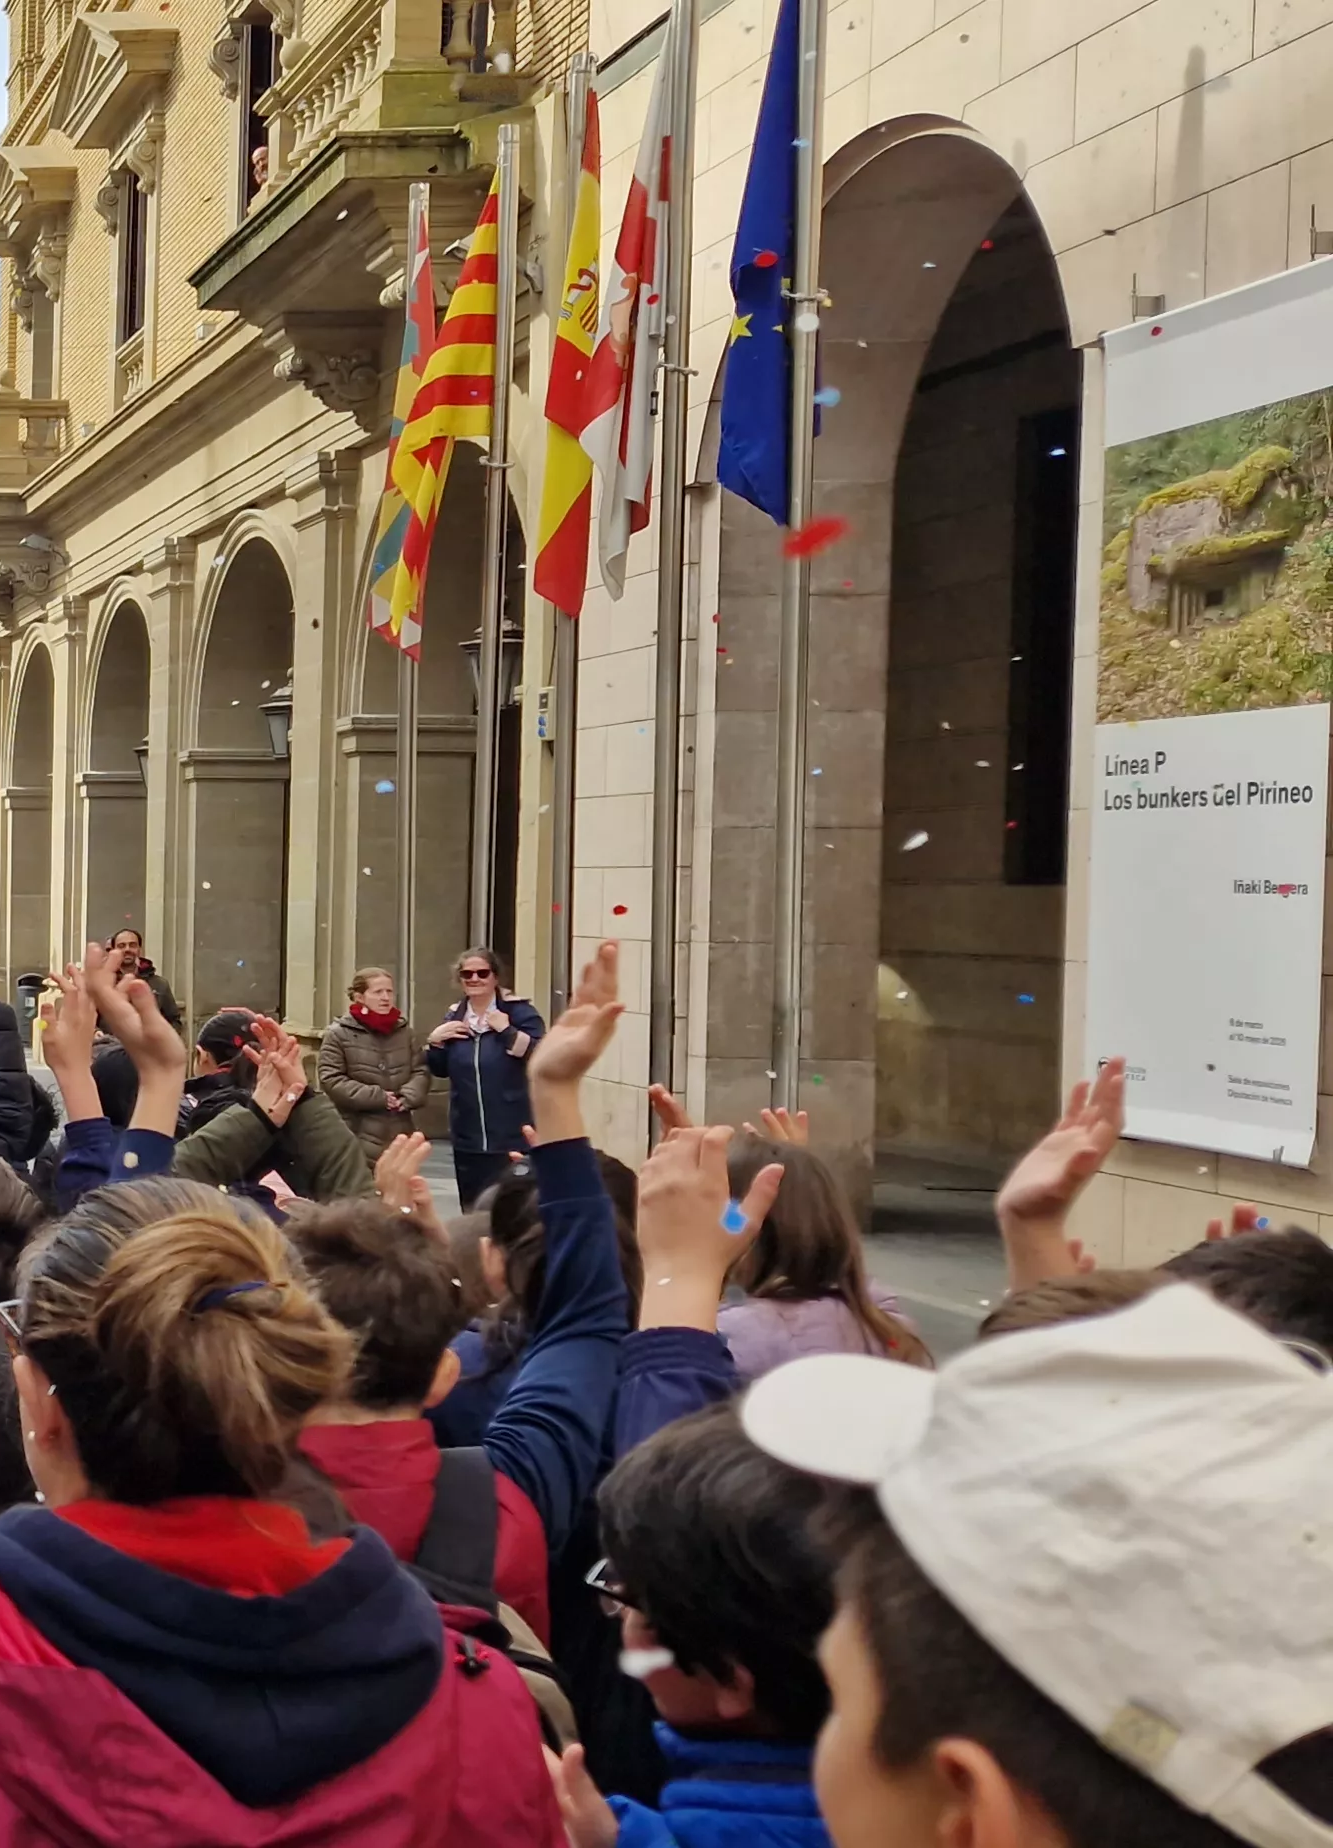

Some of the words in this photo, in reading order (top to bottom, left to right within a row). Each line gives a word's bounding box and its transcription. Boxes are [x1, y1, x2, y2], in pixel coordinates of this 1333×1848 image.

[1105, 754, 1150, 777] Línea
[1154, 751, 1167, 774] P
[1104, 789, 1133, 811] Los
[1136, 786, 1208, 810] bunkers
[1247, 781, 1313, 806] Pirineo
[1233, 879, 1261, 895] Iñaki
[1263, 879, 1309, 899] Beera
